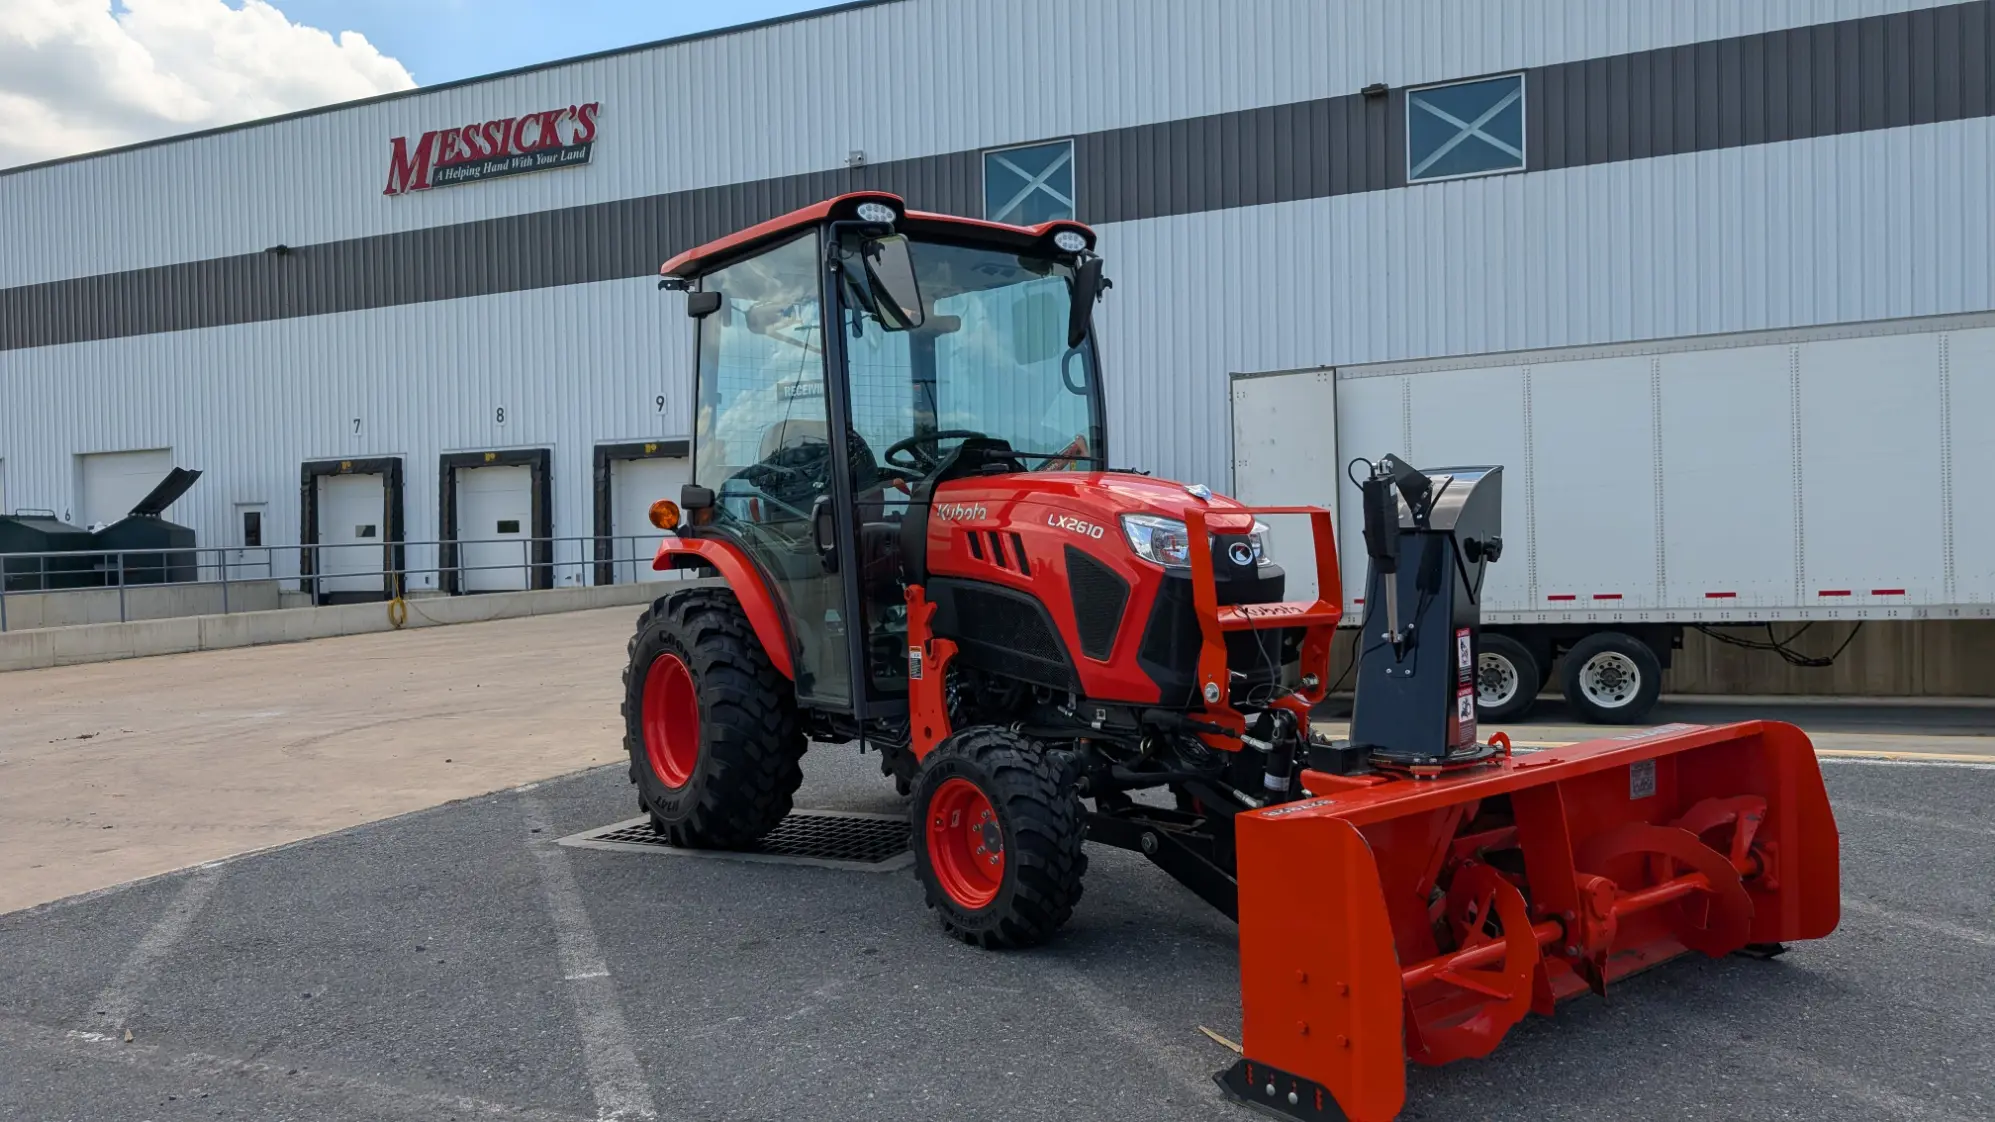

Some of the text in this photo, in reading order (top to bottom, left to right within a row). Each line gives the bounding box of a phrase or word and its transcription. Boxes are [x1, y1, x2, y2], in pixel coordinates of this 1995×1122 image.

[383, 102, 599, 195] MESSICK'S
[436, 147, 586, 182] A Helping Hand With Your Land
[784, 383, 823, 397] RECEIVI
[656, 395, 664, 412] 9
[496, 407, 504, 423] 8
[353, 418, 360, 433] 7
[65, 508, 71, 521] 6
[937, 502, 987, 521] Kubota
[1047, 513, 1104, 539] LX2610
